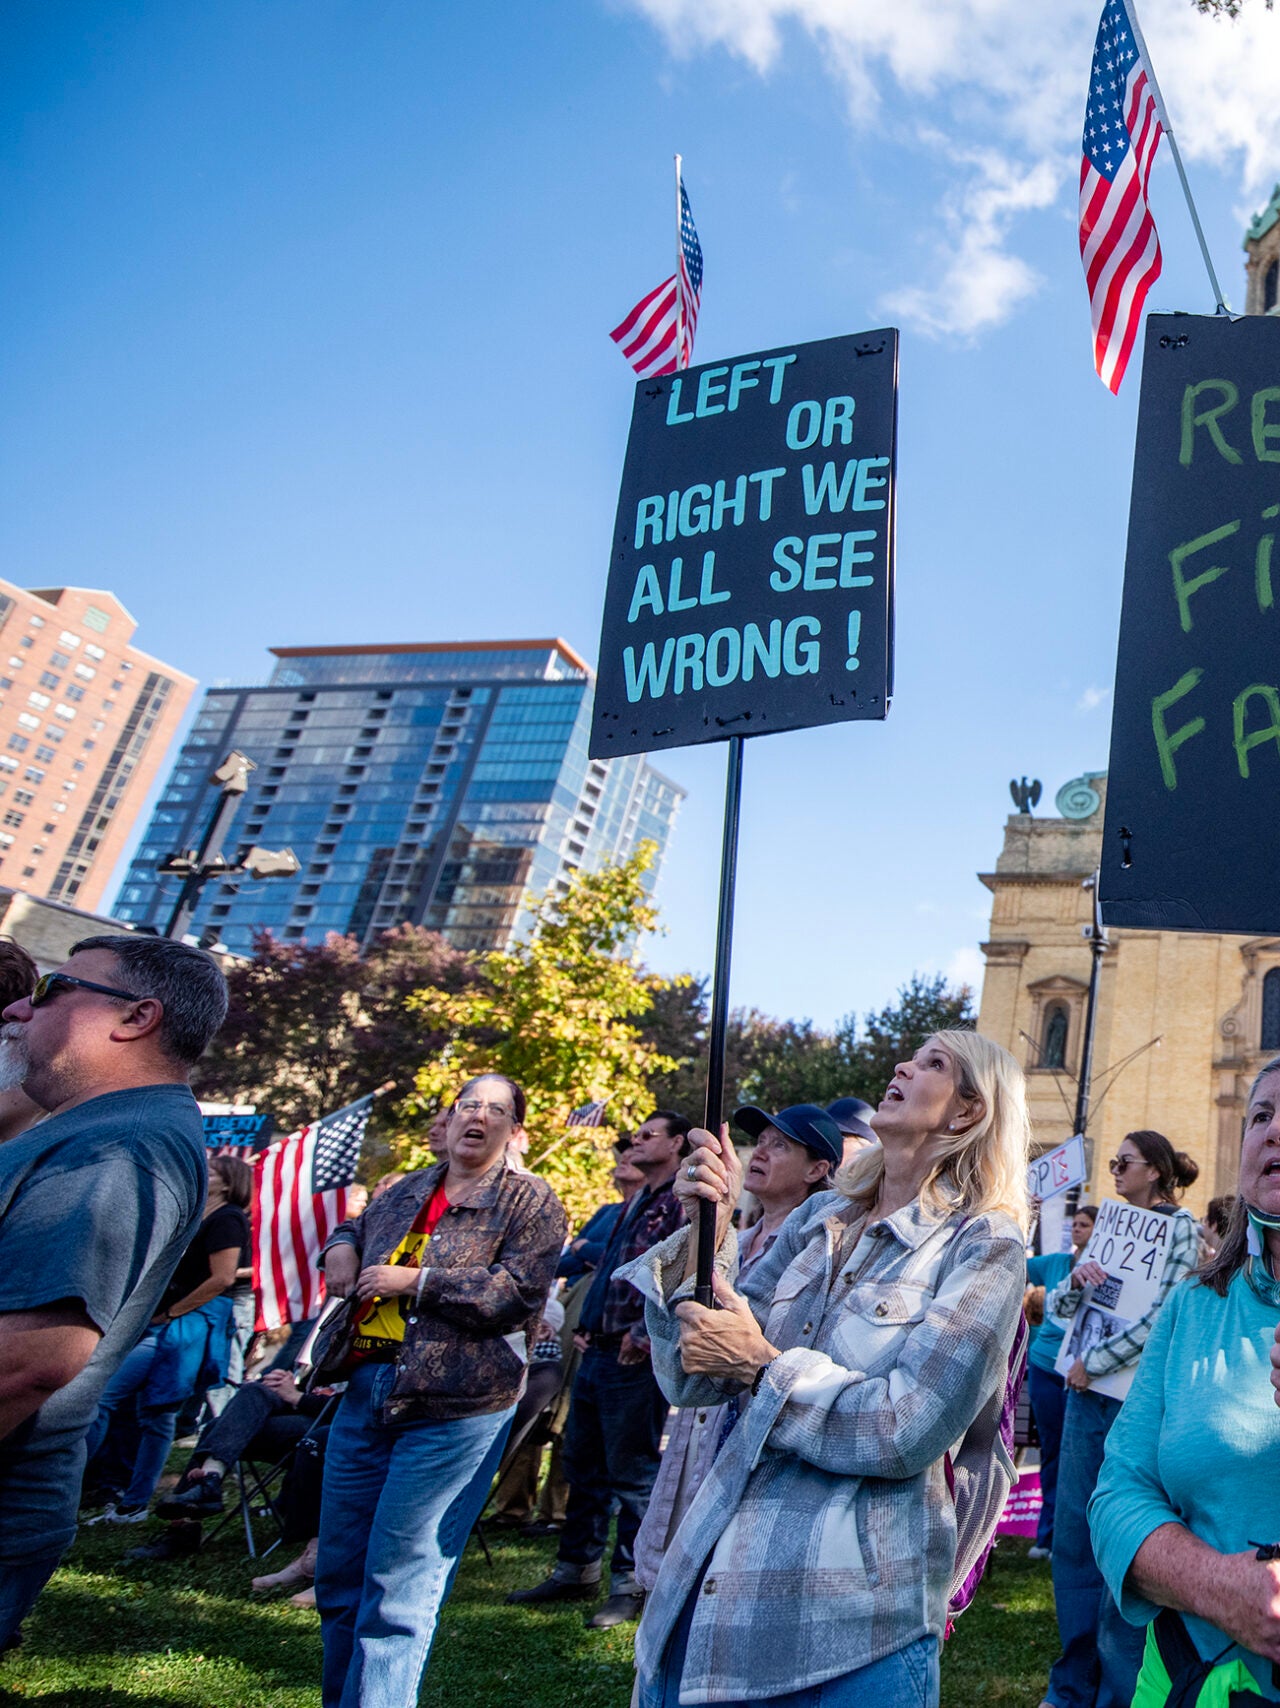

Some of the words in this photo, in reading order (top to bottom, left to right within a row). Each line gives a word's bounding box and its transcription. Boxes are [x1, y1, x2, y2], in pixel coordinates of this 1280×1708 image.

[666, 354, 797, 425] LEFT
[786, 396, 855, 450] OR
[634, 467, 786, 549] RIGHT
[802, 456, 890, 516] WE
[627, 551, 731, 623] ALL
[769, 530, 877, 592] SEE
[203, 1114, 268, 1132] LIBERTY
[205, 1133, 257, 1148] STICE
[1096, 1203, 1168, 1246] AMERICA
